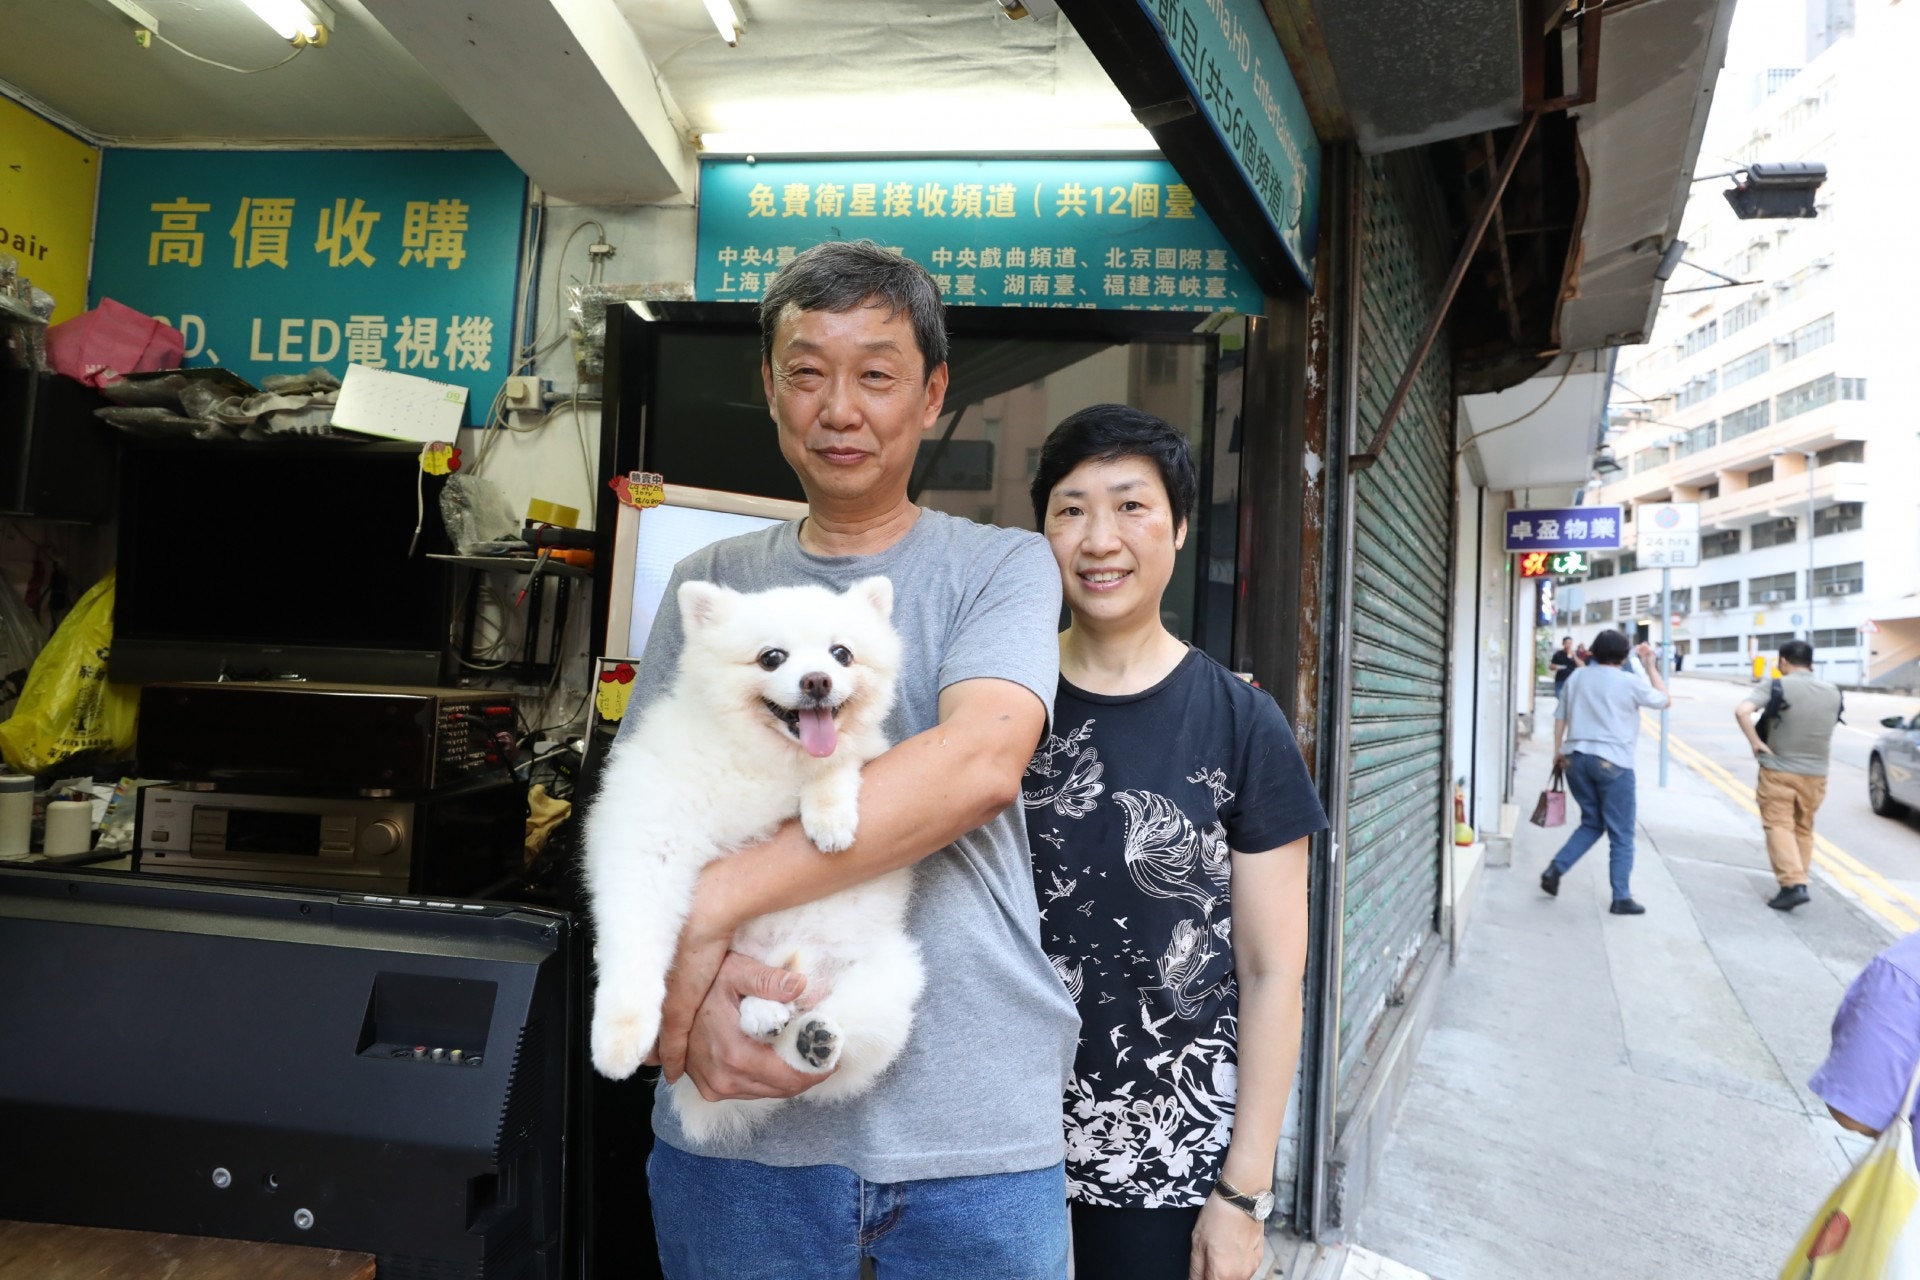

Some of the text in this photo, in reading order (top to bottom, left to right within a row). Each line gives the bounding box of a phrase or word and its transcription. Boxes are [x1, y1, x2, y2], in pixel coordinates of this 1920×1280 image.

[148, 197, 470, 270] 高價收購
[446, 391, 461, 401] 09
[1510, 517, 1617, 541] 卓盈物業
[1645, 536, 1690, 546] 24 hrs
[1649, 550, 1685, 563] 全日
[1023, 785, 1054, 800] ROOTS
